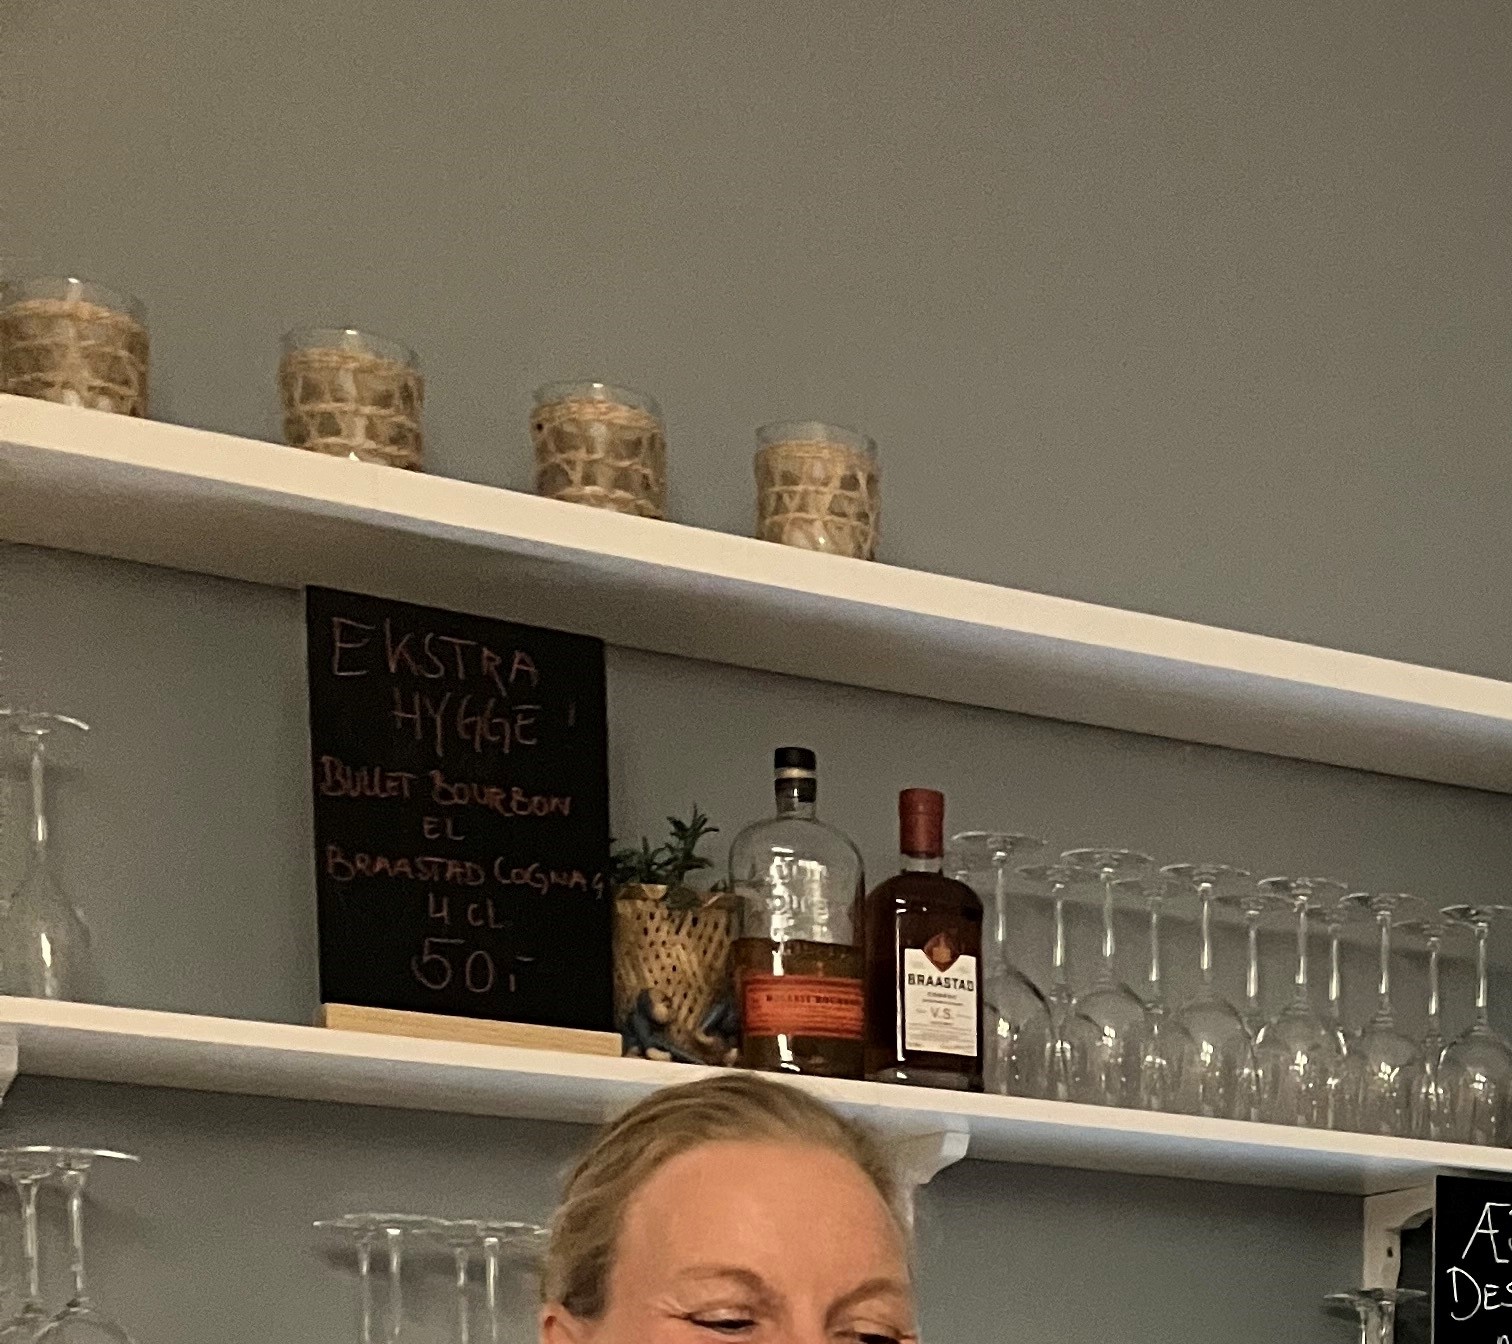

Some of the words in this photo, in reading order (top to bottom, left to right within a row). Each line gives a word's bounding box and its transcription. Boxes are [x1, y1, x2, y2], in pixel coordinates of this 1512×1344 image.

[331, 615, 541, 697] EKSTRA
[428, 769, 573, 817] BOURBON
[422, 816, 466, 841] EL
[427, 893, 450, 926] 4
[908, 973, 974, 992] BRAASTAD
